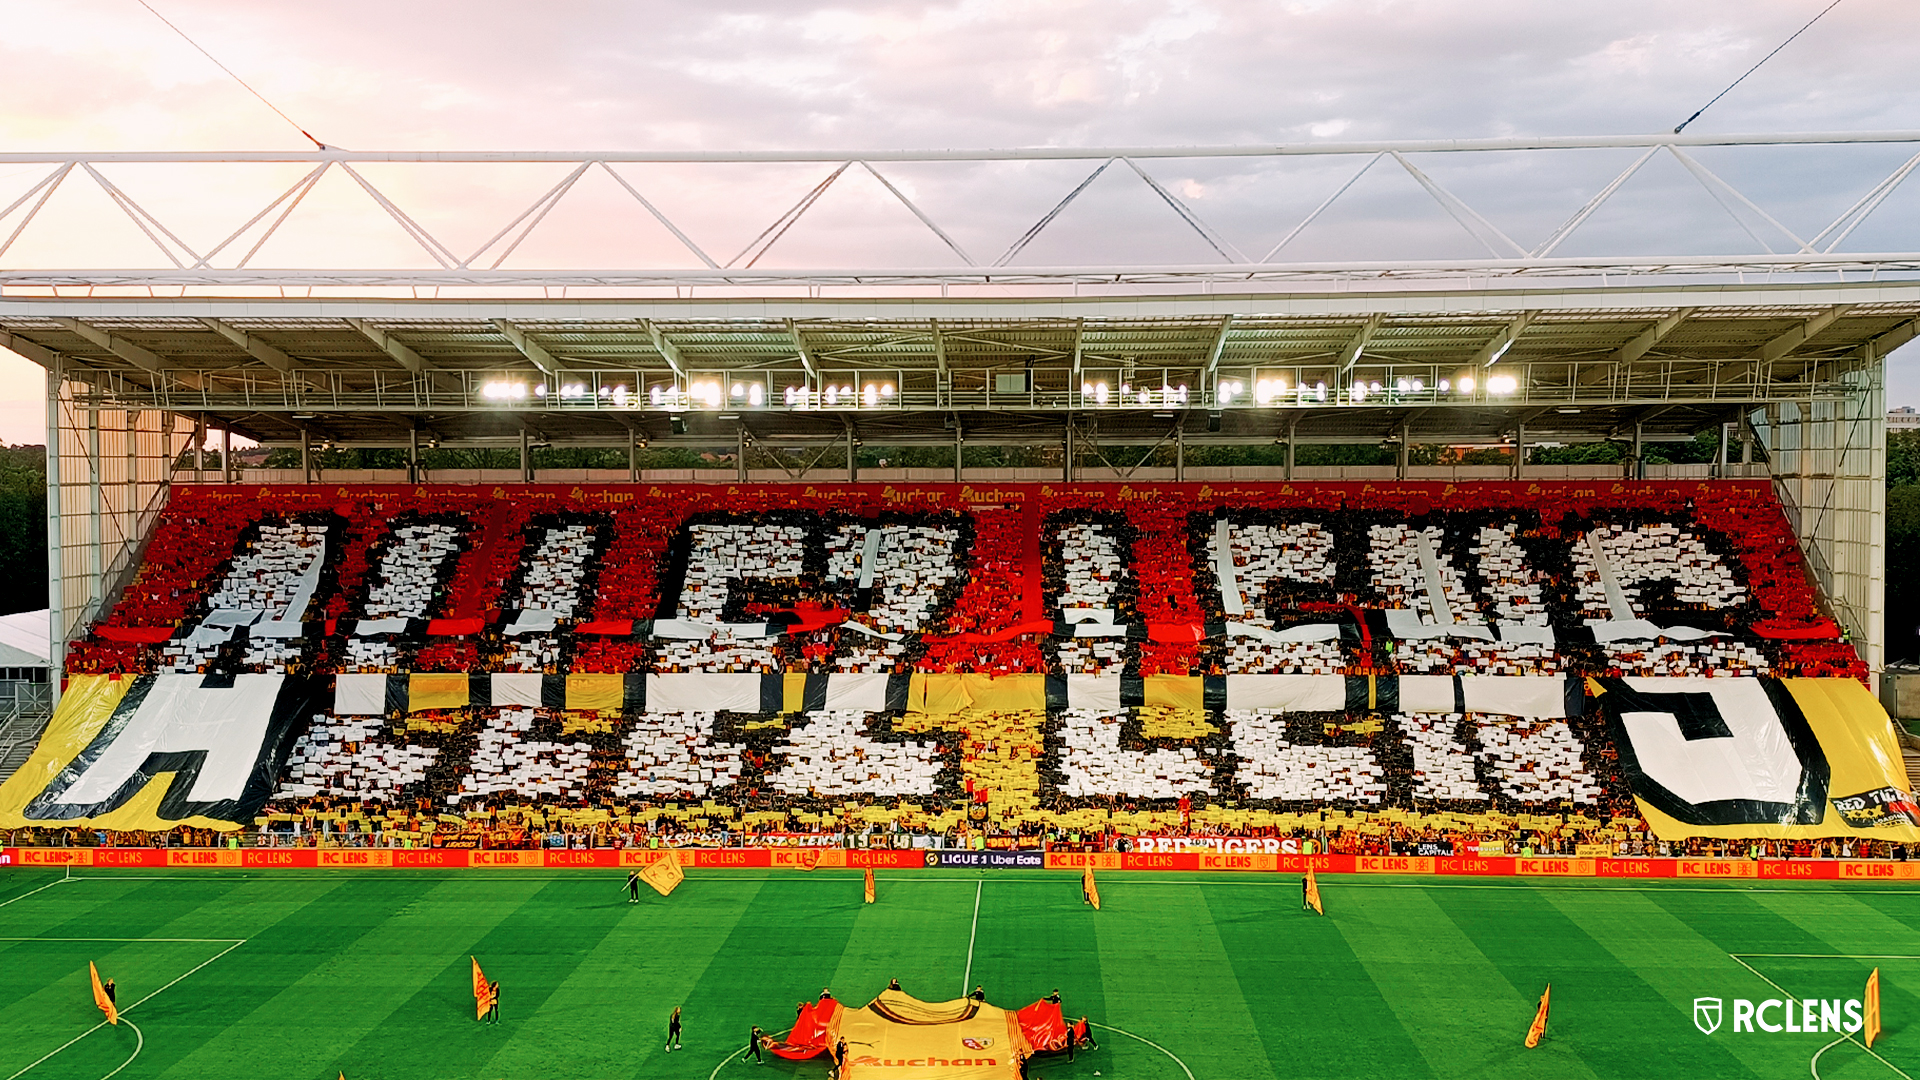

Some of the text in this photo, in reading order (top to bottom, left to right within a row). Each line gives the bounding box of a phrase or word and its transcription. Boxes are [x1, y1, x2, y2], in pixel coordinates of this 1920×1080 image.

[959, 486, 1023, 502] Auchan
[1833, 797, 1866, 811] RED
[25, 852, 68, 864] RC LENS
[99, 852, 142, 864] RC LENS
[172, 852, 216, 864] RC LENS
[248, 852, 292, 864] RC LENS
[323, 852, 367, 864] RC LENS
[399, 852, 442, 864] RC LENS
[474, 852, 518, 864] RC LENS
[550, 852, 594, 864] RC LENS
[625, 852, 668, 864] RC LEN
[701, 853, 745, 864] RC LENS
[776, 853, 793, 865] RC
[853, 853, 897, 865] RC LENS
[941, 855, 978, 865] LIGUE
[991, 855, 1015, 865] Uber
[1017, 855, 1042, 865] Eats
[1046, 854, 1062, 867] RC
[1127, 855, 1173, 868] RC LENS
[1205, 856, 1251, 869] RC LENS
[1283, 857, 1299, 870] RC
[1360, 858, 1408, 871] RC LENS
[1441, 859, 1488, 872] RC LENS
[1522, 860, 1568, 873] RC LENS
[1603, 861, 1649, 874] RC LENS
[1683, 862, 1730, 875] RC LENS
[1764, 862, 1811, 875] RC LENS
[1846, 863, 1894, 876] RC LENS
[850, 1055, 997, 1067] Auchan
